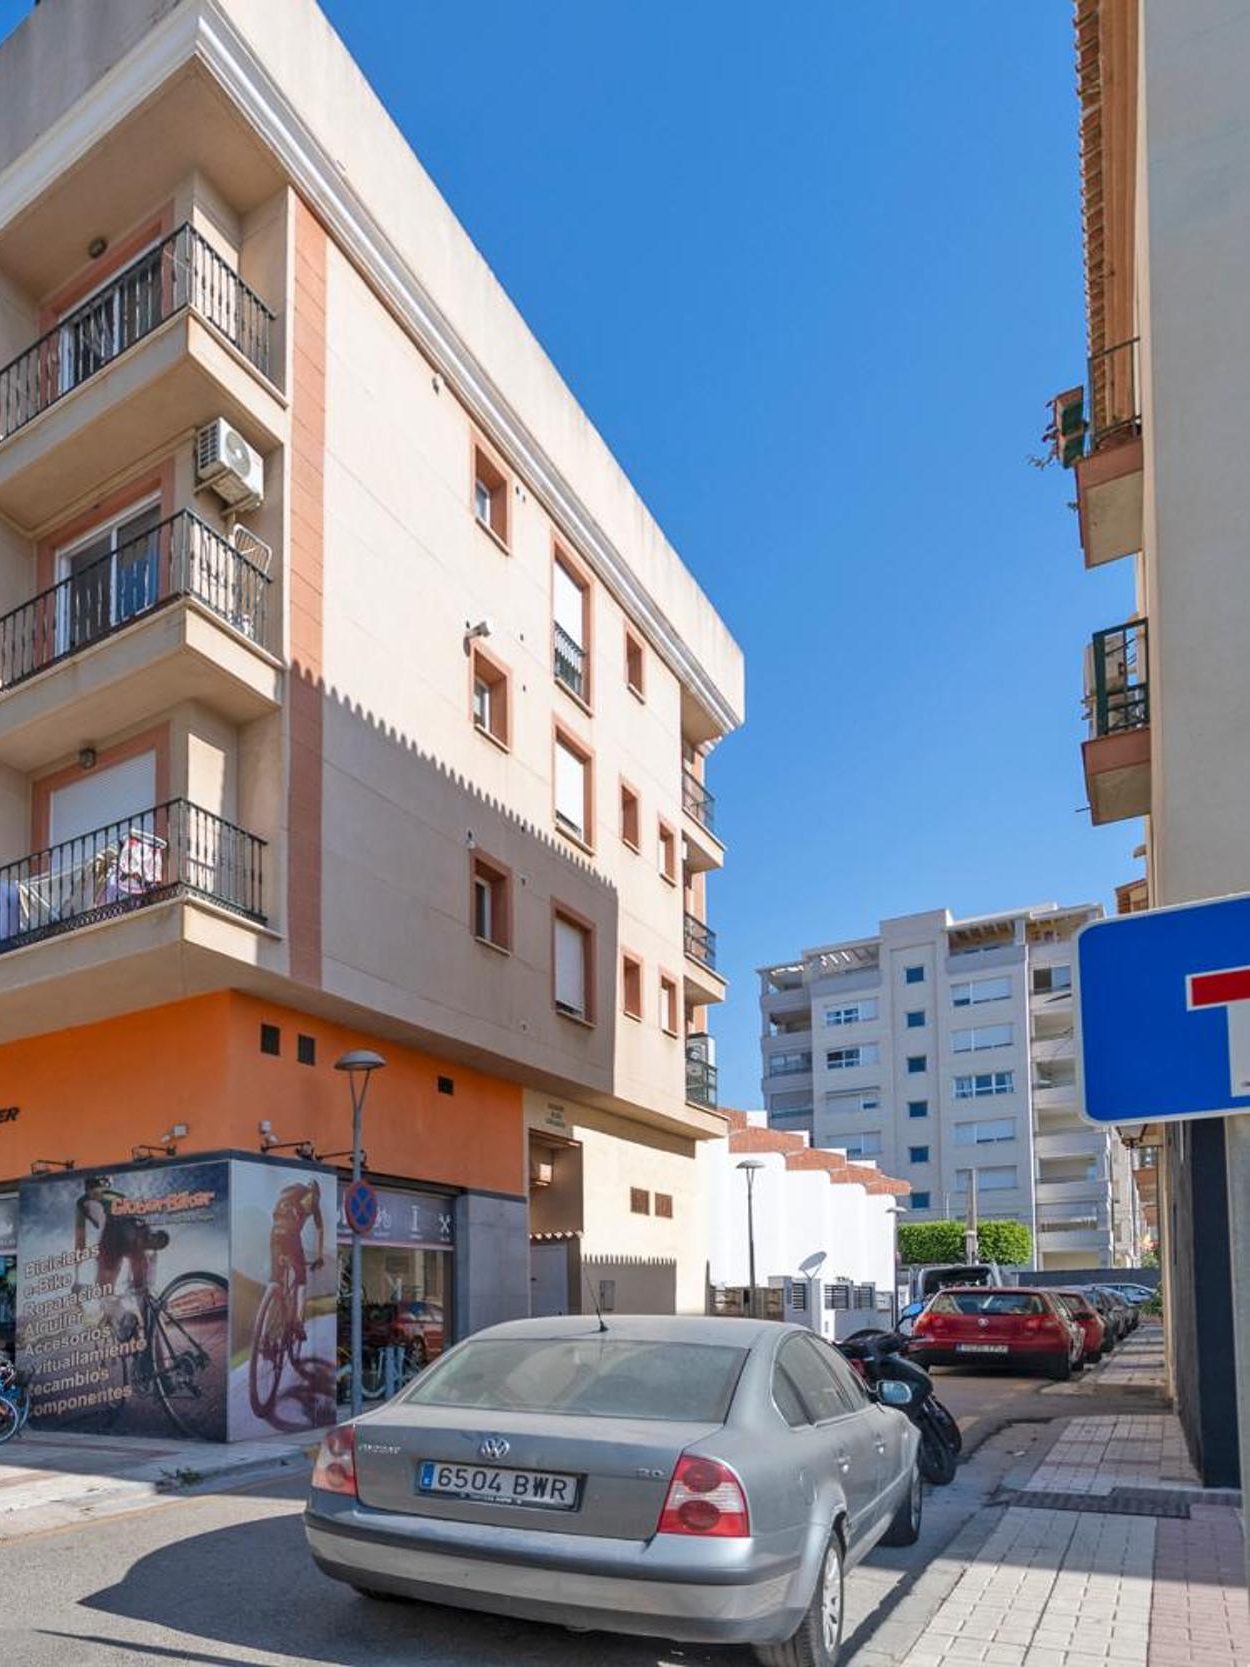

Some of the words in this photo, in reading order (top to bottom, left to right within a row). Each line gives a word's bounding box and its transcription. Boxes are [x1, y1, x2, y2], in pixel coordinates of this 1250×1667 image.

[24, 1246, 100, 1278] Bicicletas
[23, 1273, 73, 1300] e-Bike
[24, 1282, 113, 1318] Reparación
[25, 1325, 111, 1356] Accesorios
[29, 1337, 147, 1375] vituallamiento
[29, 1384, 132, 1416] omponentes
[438, 1467, 501, 1493] 6504
[513, 1474, 567, 1501] BWR
